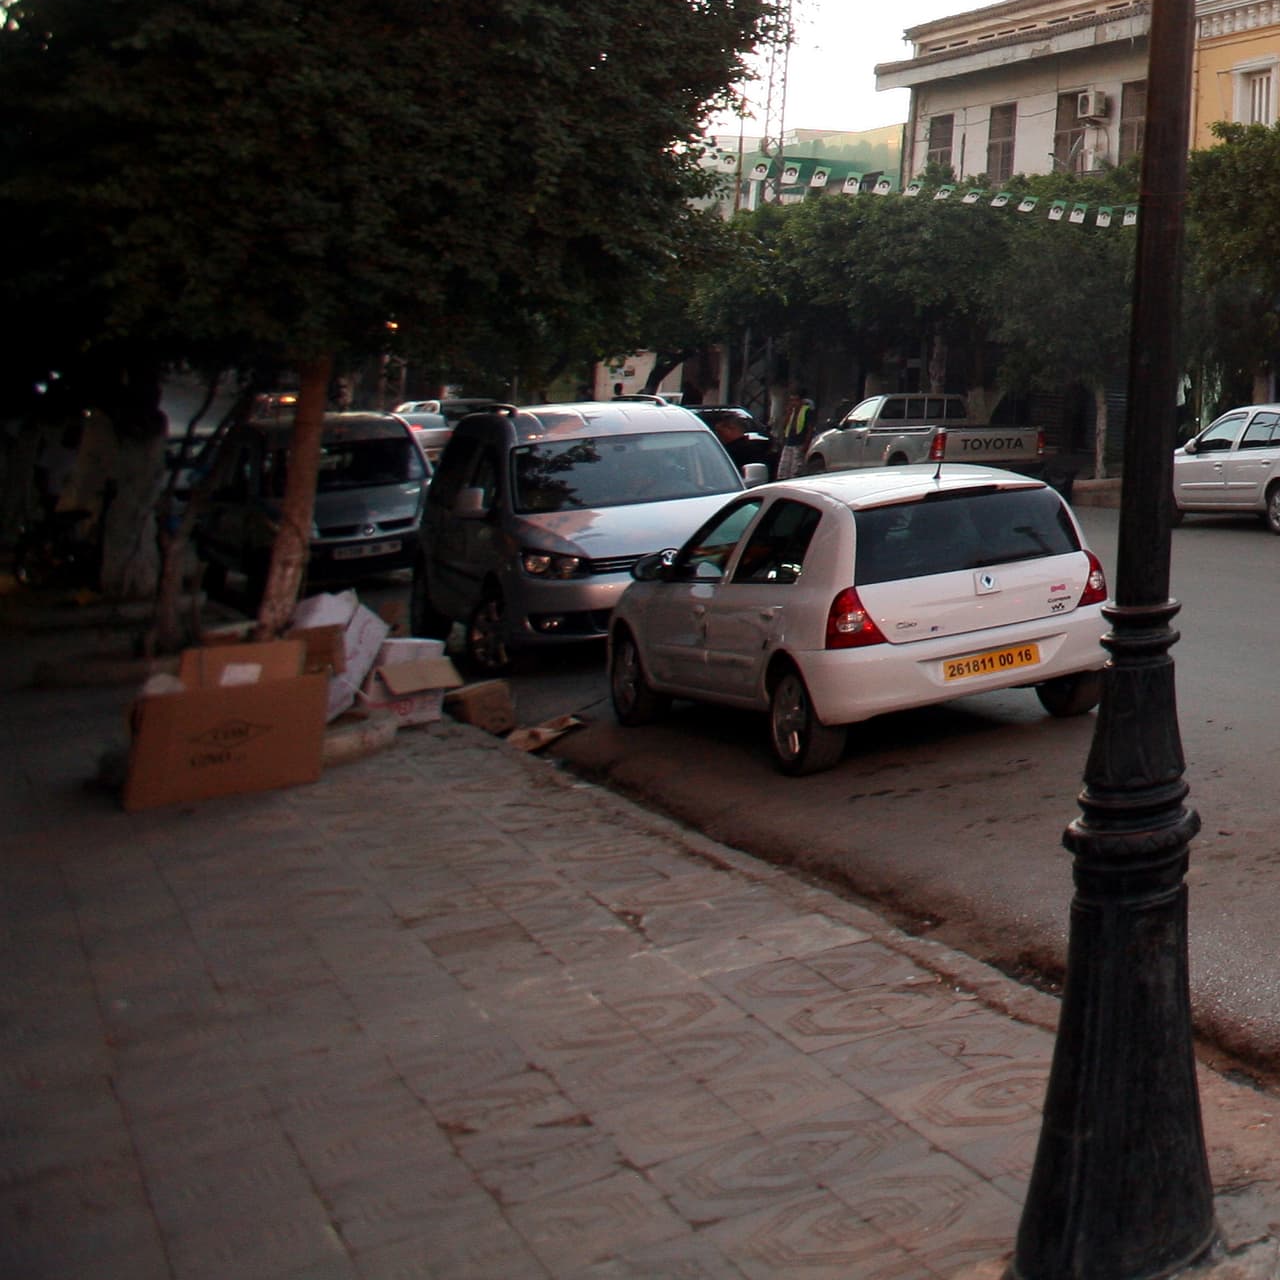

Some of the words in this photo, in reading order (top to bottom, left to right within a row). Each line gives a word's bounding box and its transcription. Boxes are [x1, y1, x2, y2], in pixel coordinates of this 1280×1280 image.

[961, 438, 1024, 450] TOYOTA
[948, 656, 995, 677] 261811
[999, 653, 1014, 666] 00
[1017, 648, 1032, 663] 16
